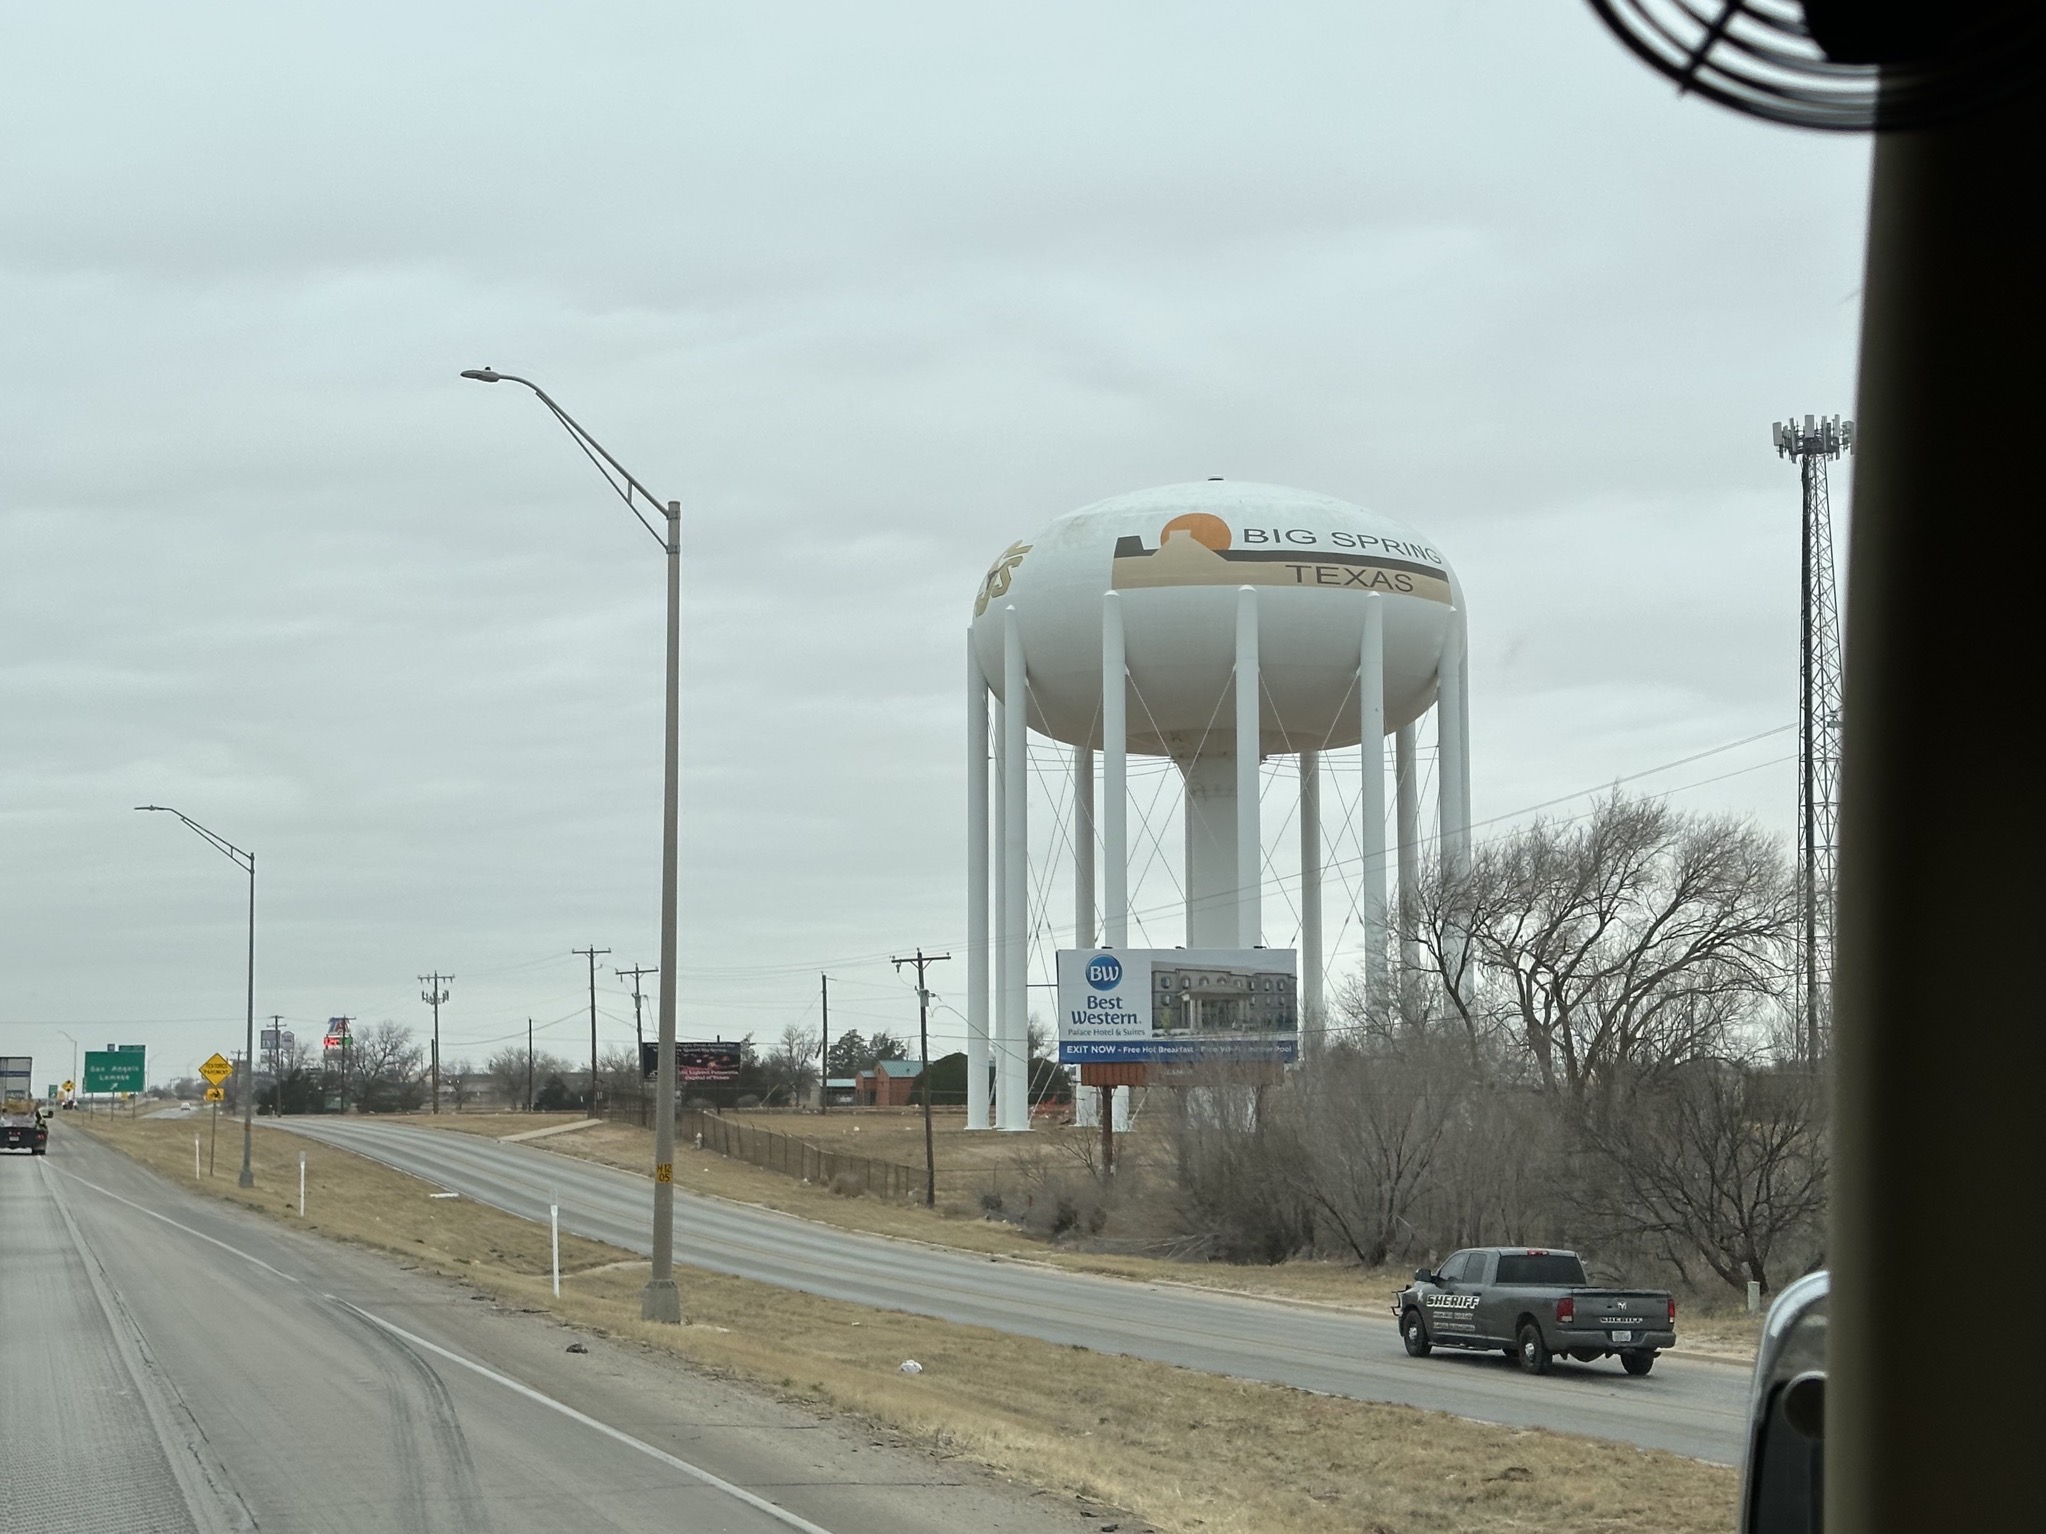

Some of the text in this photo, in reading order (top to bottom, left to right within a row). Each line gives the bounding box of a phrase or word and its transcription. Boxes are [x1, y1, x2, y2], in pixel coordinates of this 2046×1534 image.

[1243, 528, 1442, 564] BIG SPRING
[1285, 564, 1414, 592] TEXAS
[1090, 966, 1119, 981] BW
[1087, 995, 1123, 1010] Best
[1071, 1010, 1138, 1025] Western
[1068, 1028, 1092, 1036] Palace
[1093, 1028, 1114, 1036] Hotel
[1123, 1028, 1146, 1036] Suites
[1426, 1294, 1480, 1309] SHERIFF
[1600, 1316, 1643, 1324] SHERIFF
